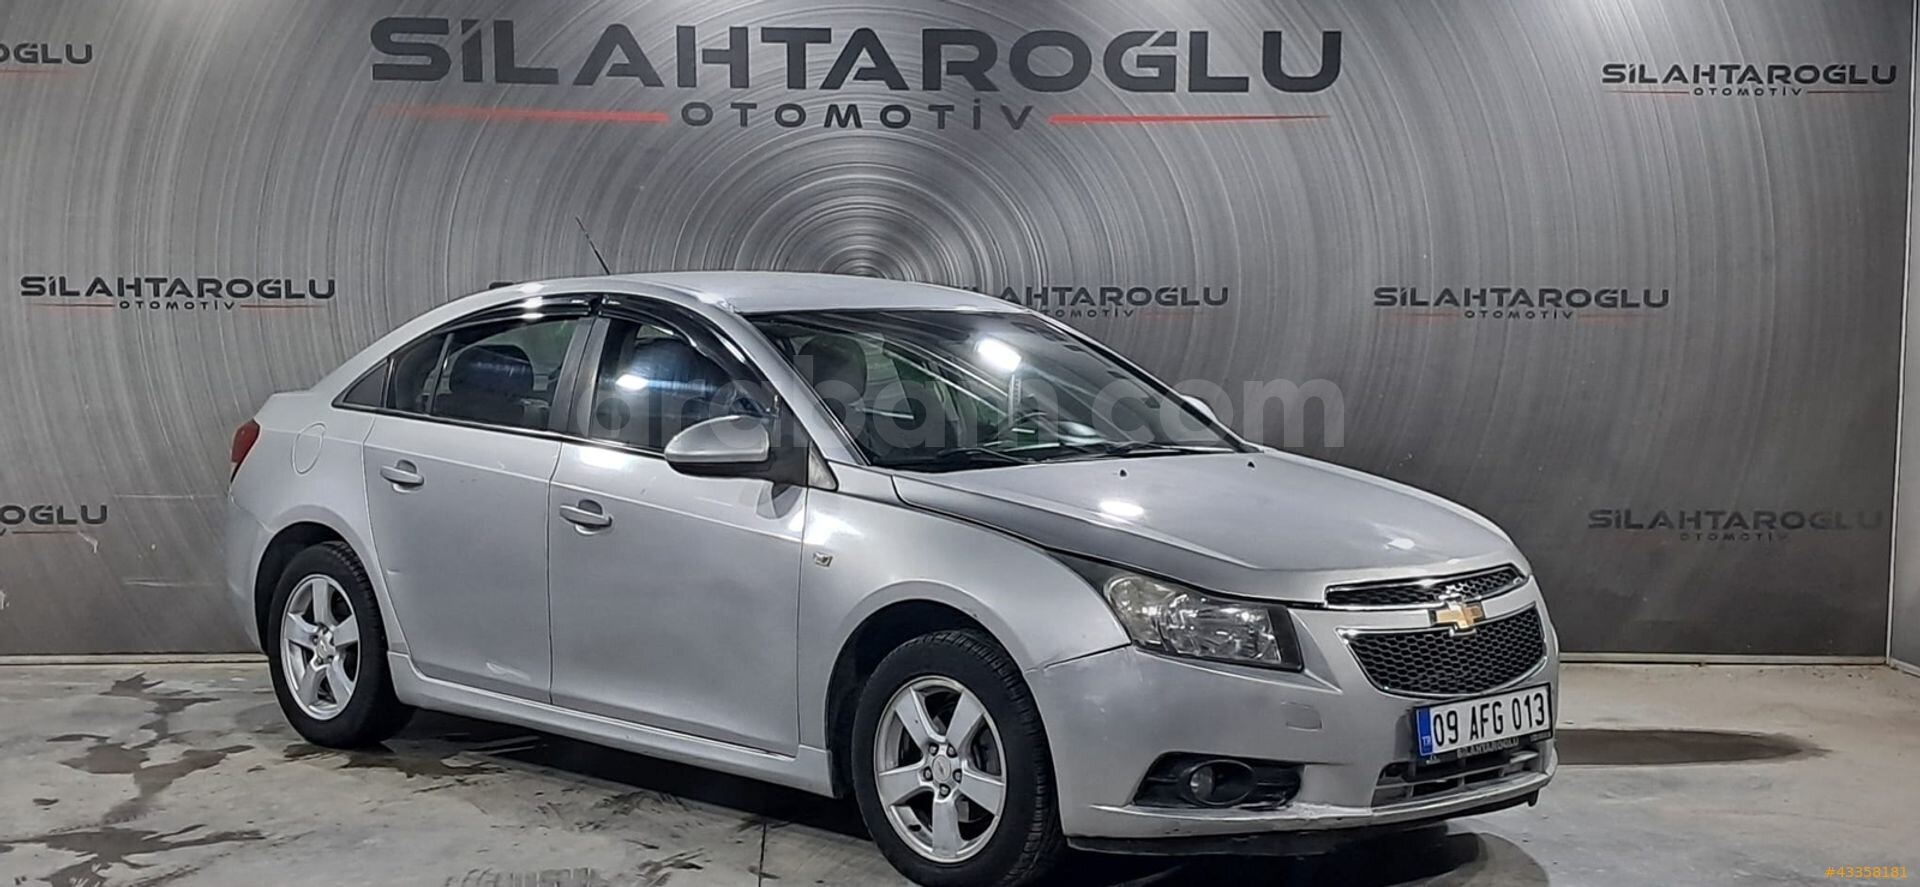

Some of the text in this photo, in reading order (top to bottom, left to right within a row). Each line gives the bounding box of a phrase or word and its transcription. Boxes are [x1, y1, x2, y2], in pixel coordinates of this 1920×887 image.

[1693, 87, 1802, 96] OTOMOTİV
[682, 97, 1034, 131] OTOMOTİV
[119, 300, 235, 310] OTOMOTİV
[1464, 310, 1574, 319] OTOMOTİV
[1432, 692, 1545, 747] 09 AFG 013
